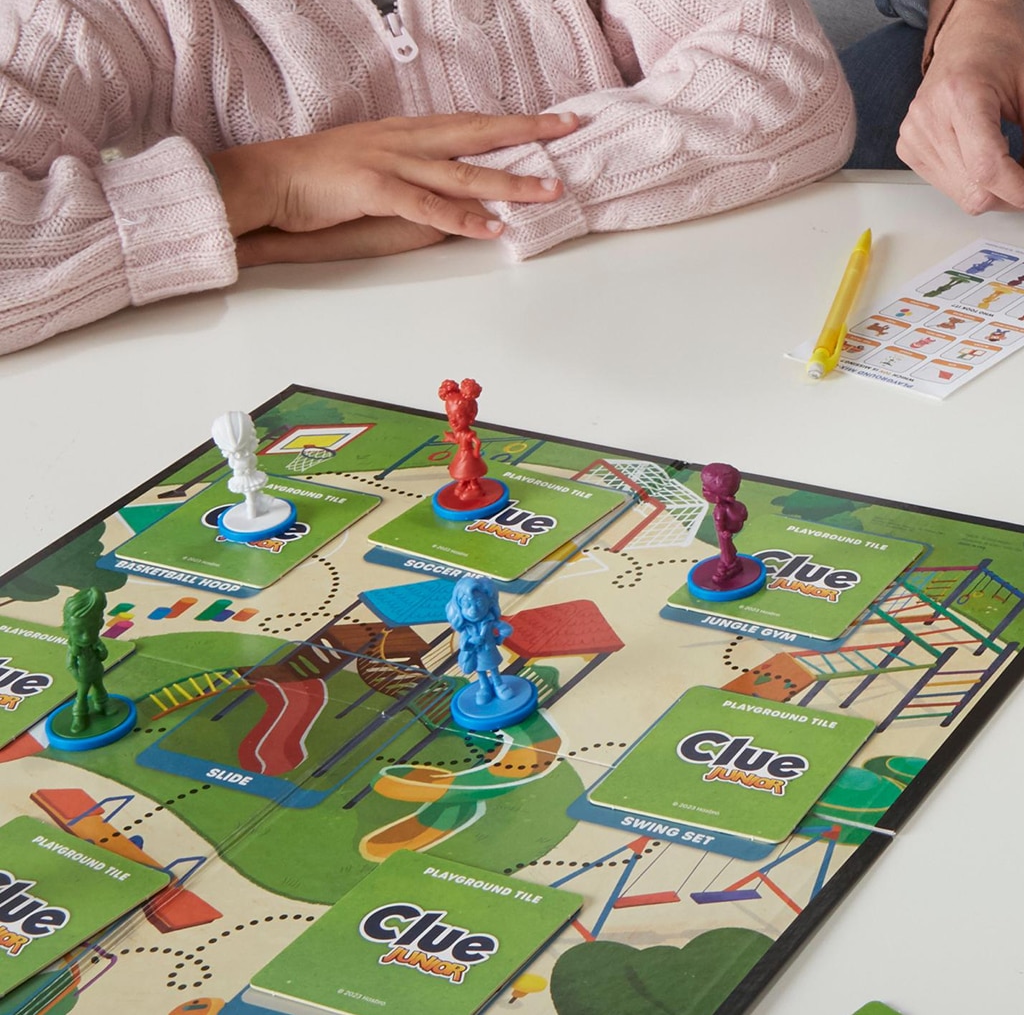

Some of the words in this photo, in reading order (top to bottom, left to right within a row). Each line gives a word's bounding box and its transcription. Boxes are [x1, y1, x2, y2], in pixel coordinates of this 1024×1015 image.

[962, 306, 978, 314] TOOK
[978, 310, 994, 318] WHO
[858, 370, 914, 388] PLAYGROUND
[265, 483, 323, 500] AYGROUND
[324, 491, 347, 504] TILE
[503, 471, 570, 493] PLAYGROUND
[570, 487, 593, 499] TILE
[467, 520, 531, 545] JUNIOR
[786, 525, 862, 546] PLAYGROUND
[863, 539, 888, 551] TILE
[114, 560, 197, 586] BASKETBALL
[198, 576, 241, 592] HOOP
[403, 559, 462, 577] SOCCER
[755, 551, 858, 588] Clue
[768, 578, 840, 602] JUNIOR
[700, 615, 761, 636] JUNGLE
[760, 628, 797, 643] GYM
[722, 699, 808, 724] PLAYGROUND
[810, 716, 838, 730] TILE
[680, 732, 807, 778] Clue
[205, 768, 254, 787] SLIDE
[704, 767, 786, 795] JUNIOR
[678, 803, 697, 811] 2023
[620, 816, 684, 838] SWING
[684, 831, 716, 847] SET
[32, 836, 105, 871] PLAYGROUND
[104, 866, 131, 882] TILE
[423, 866, 513, 897] PLAYGROUND
[513, 888, 543, 905] TILE
[0, 873, 67, 935] lue
[363, 904, 496, 962] Clue
[381, 947, 468, 983] JUNIOR
[343, 990, 363, 1000] 2023
[361, 995, 387, 1007] Hasbro
